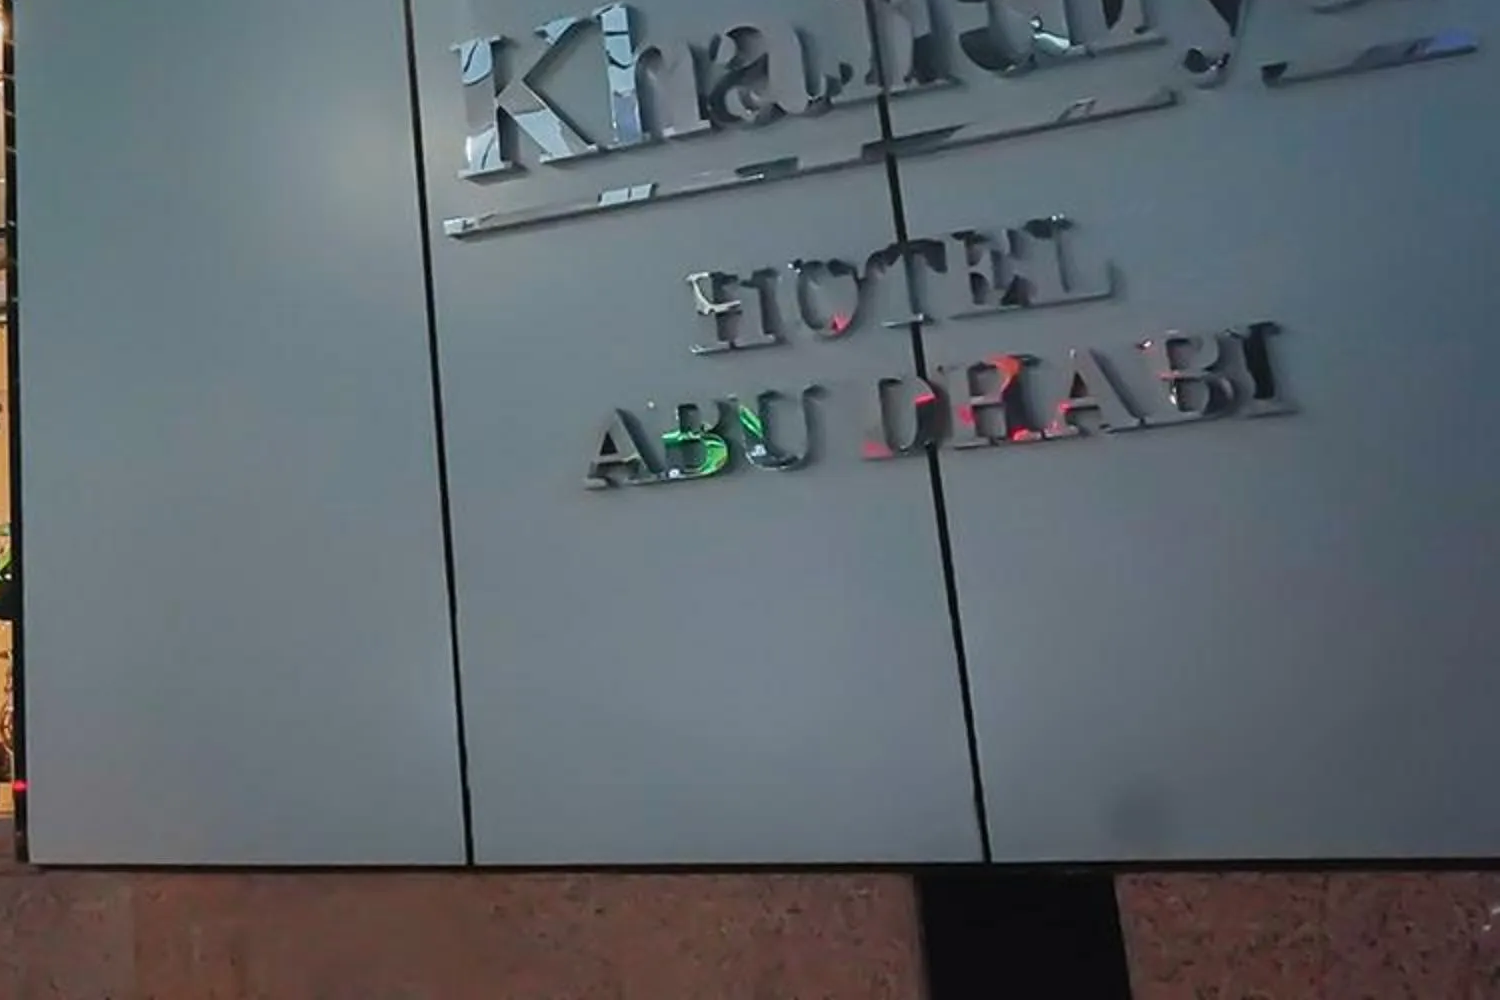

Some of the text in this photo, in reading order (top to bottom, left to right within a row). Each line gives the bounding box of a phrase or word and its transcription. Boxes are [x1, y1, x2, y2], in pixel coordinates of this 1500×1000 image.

[686, 214, 1117, 355] HOTEL
[583, 322, 1299, 489] ABU DHABI
